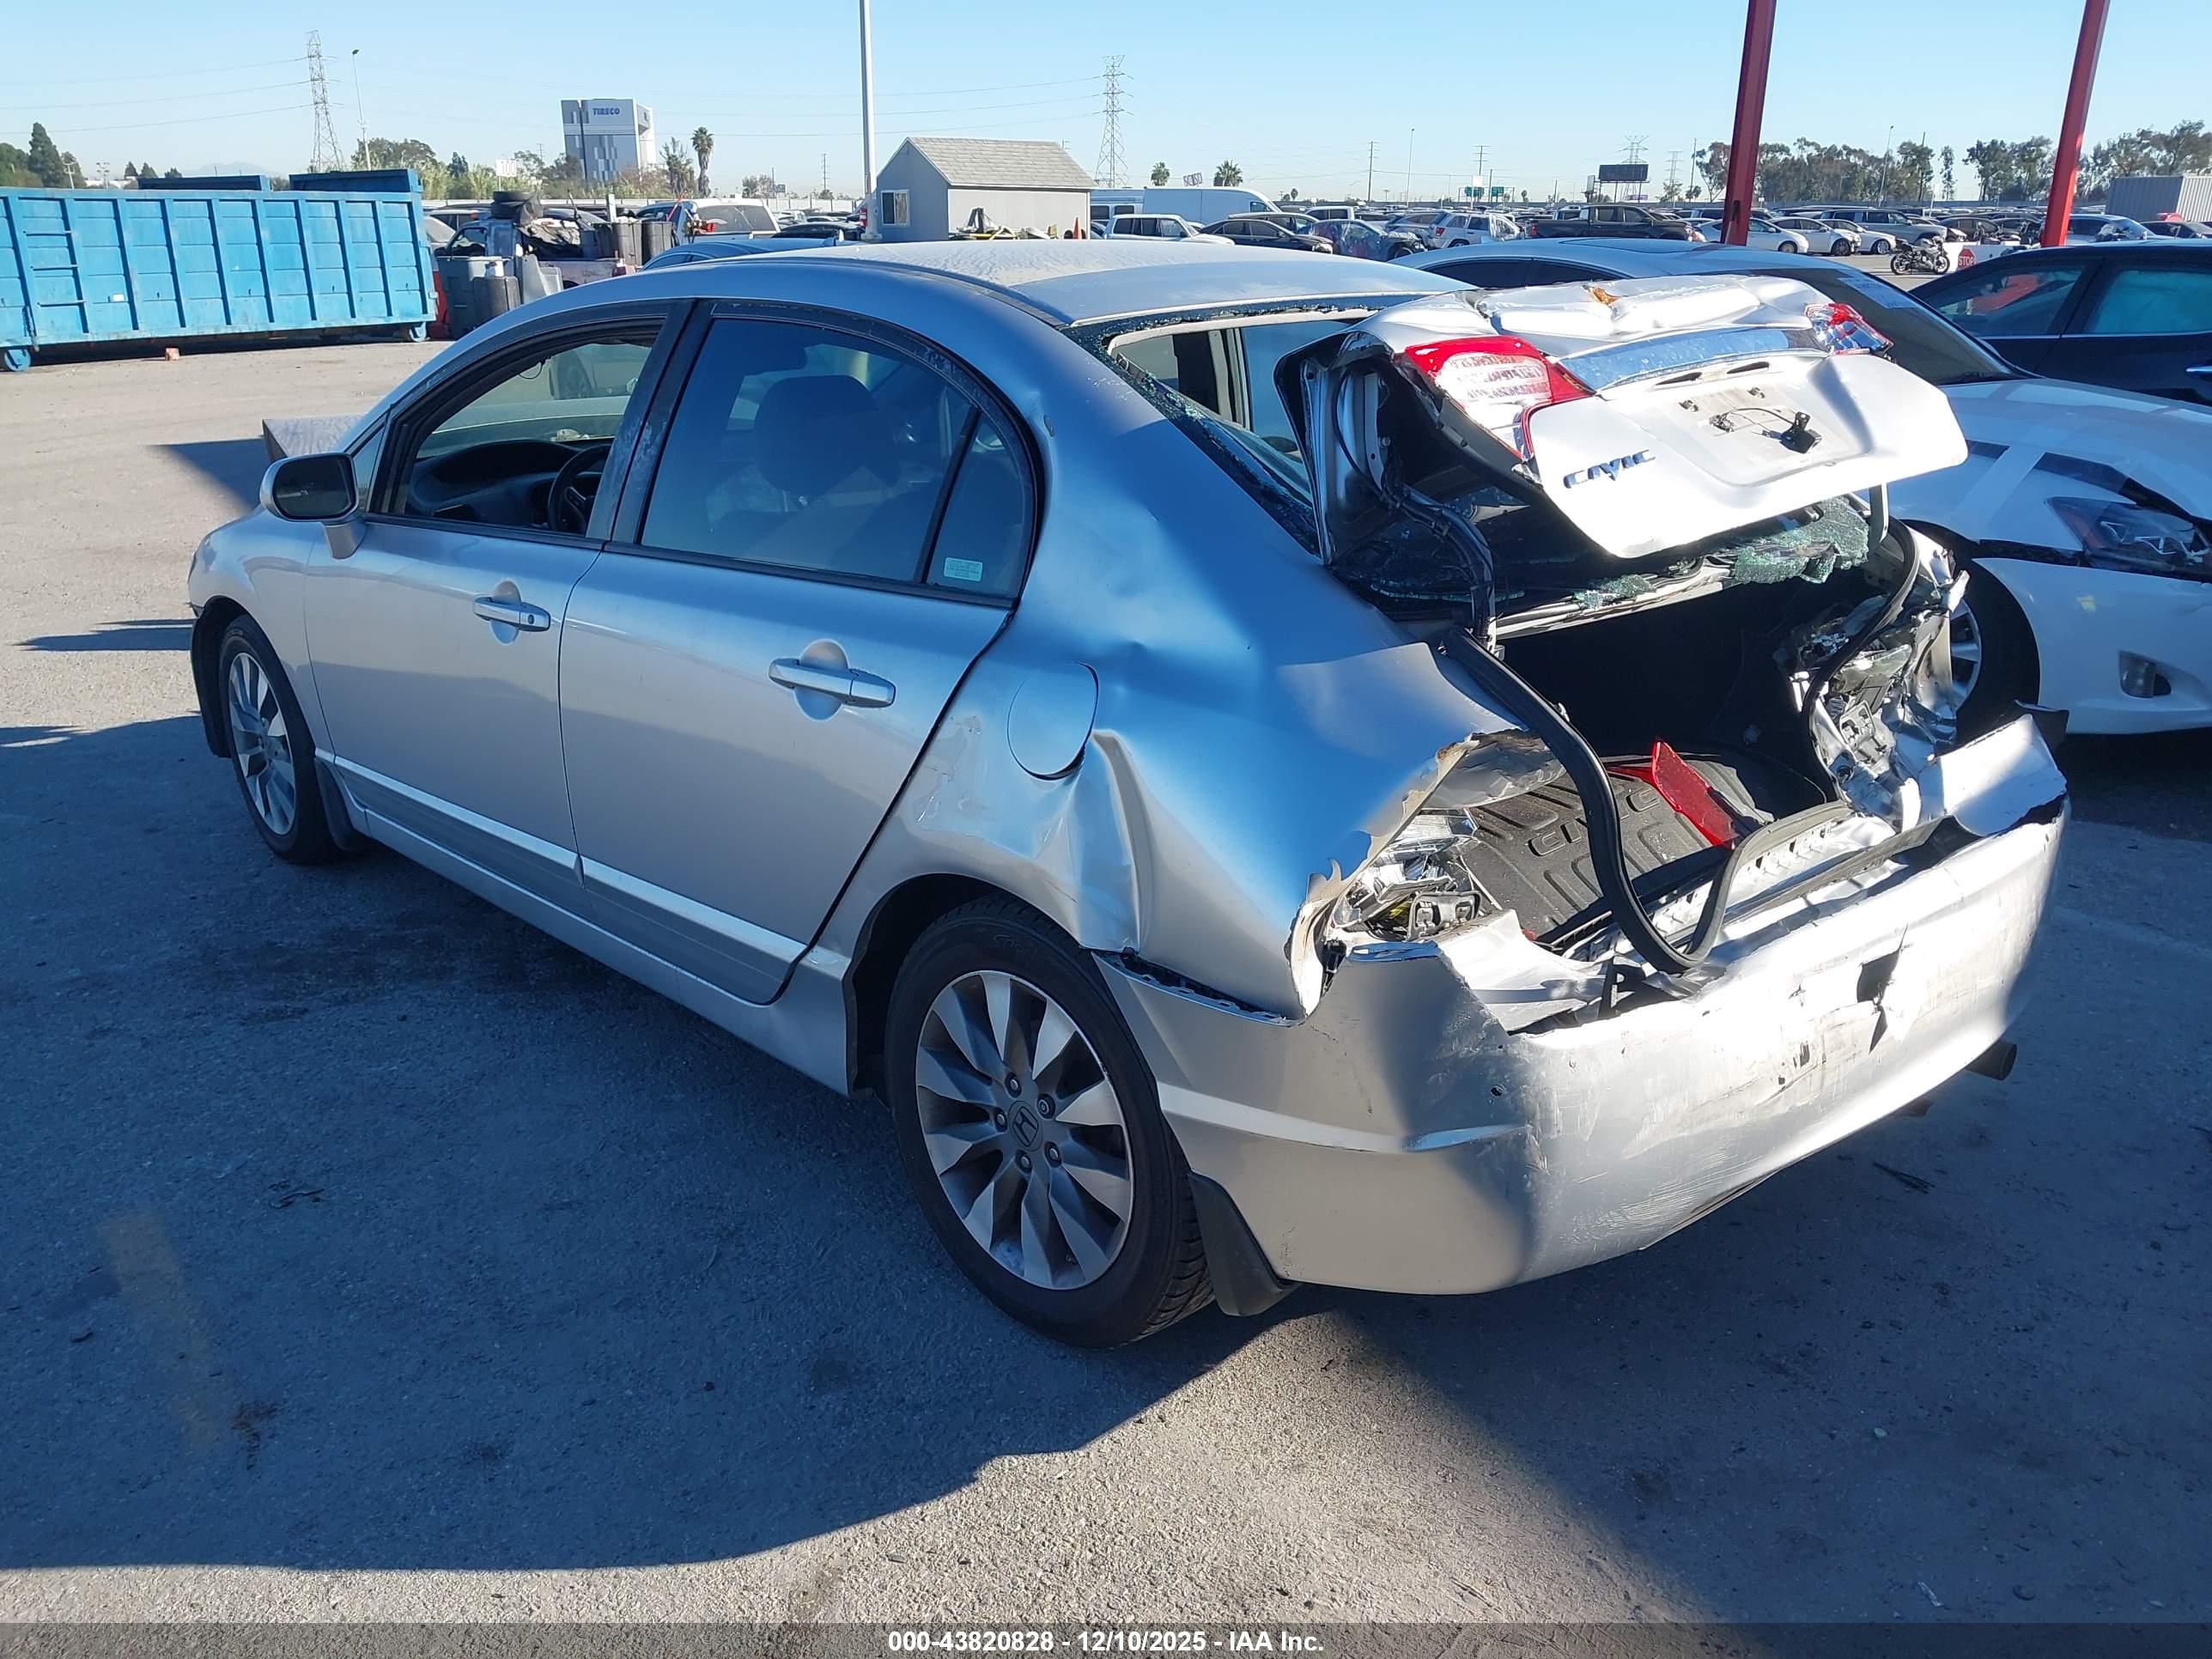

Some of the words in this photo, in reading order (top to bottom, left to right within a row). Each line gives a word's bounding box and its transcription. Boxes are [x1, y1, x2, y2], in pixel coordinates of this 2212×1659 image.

[592, 107, 620, 116] TIRECO
[1958, 256, 1974, 265] STOP
[1563, 449, 1656, 489] CIVIC
